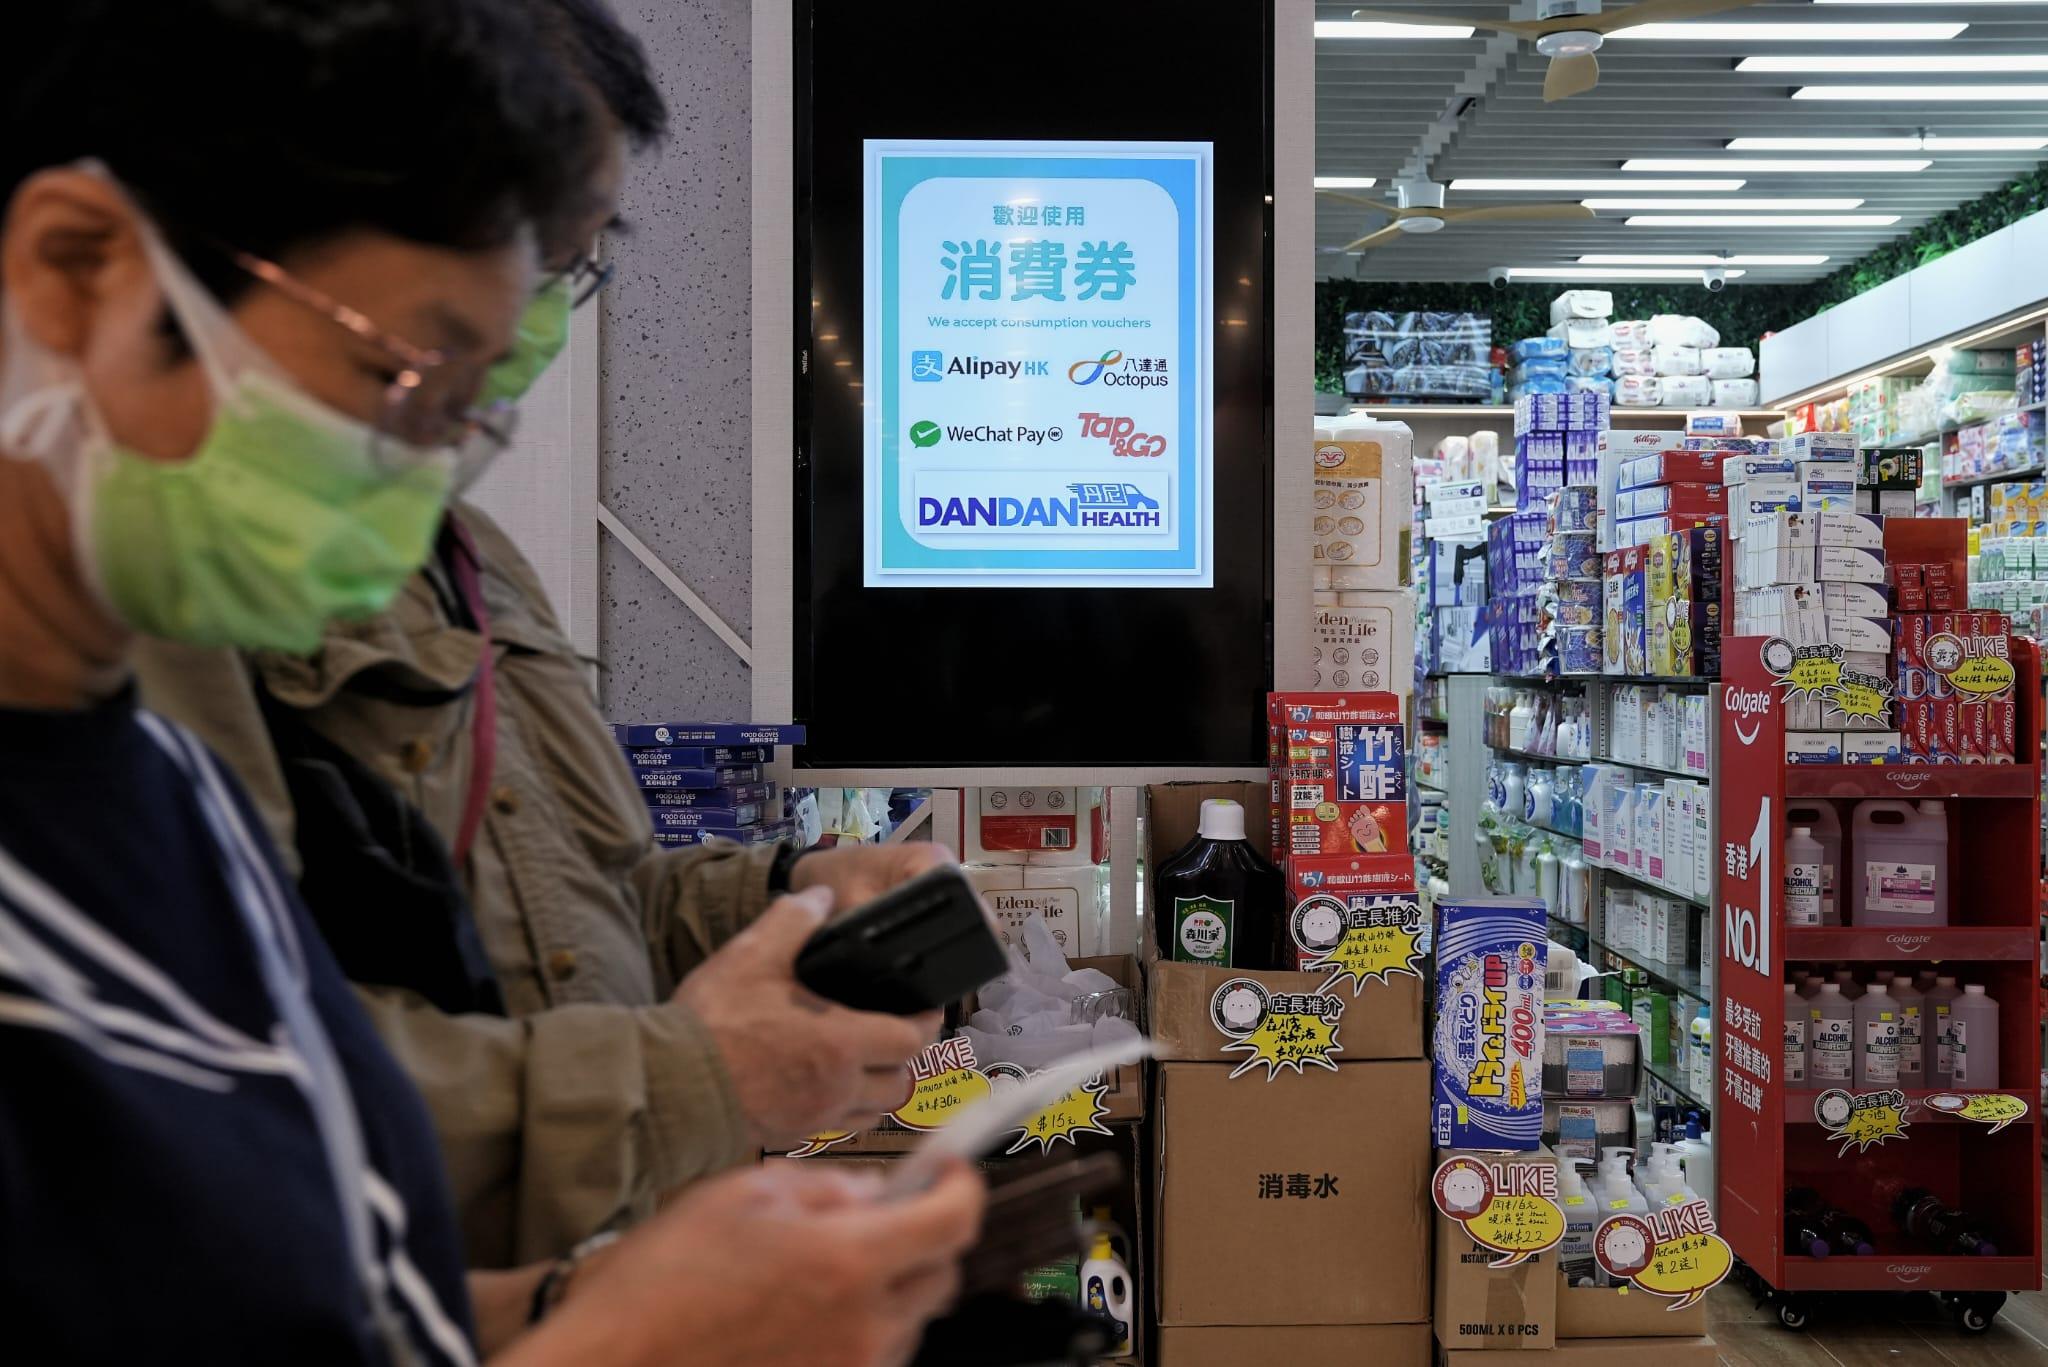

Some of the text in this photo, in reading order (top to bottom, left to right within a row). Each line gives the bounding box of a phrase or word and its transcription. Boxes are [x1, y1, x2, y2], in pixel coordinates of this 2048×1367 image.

[992, 205, 1085, 227] 歡迎使用
[940, 239, 1136, 302] 消費券
[927, 316, 1151, 331] We accept consumption vouchers
[947, 356, 1048, 379] Alipay HK
[1123, 358, 1168, 373] 八達通
[1104, 372, 1168, 389] Octopus
[947, 426, 1013, 443] WeChat
[1017, 426, 1045, 445] Pay
[1078, 412, 1134, 444] Tap
[919, 497, 1078, 527] DANDAN
[1081, 511, 1160, 527] HEALTH
[1348, 623, 1377, 636] Life
[1915, 617, 1924, 657] Colgate
[1797, 643, 1844, 659] 店長推介
[1965, 638, 2008, 658] LIKE
[1848, 672, 1893, 692] 店長推介
[1725, 686, 1771, 719] Colgate
[1918, 703, 1928, 744] Colgate
[1945, 703, 1955, 743] Colgate
[1975, 704, 1984, 744] Colgate
[2003, 704, 2013, 744] Colgate
[1339, 726, 1355, 800] 樹液シート
[1359, 726, 1395, 800] 竹酢
[1886, 771, 1931, 782] Colgate
[1725, 842, 1747, 880] 香港
[1725, 796, 1770, 977] NO. 1
[996, 896, 1034, 910] Eden
[1350, 905, 1421, 928] 店長推介
[1185, 926, 1222, 941] 森川家
[1886, 933, 1931, 945] Colgate
[1271, 996, 1342, 1016] 店長推介
[1725, 996, 1761, 1041] 最多受訪
[1819, 1032, 1849, 1042] ALCOHOL
[911, 1038, 977, 1080] LIKE
[1725, 1032, 1771, 1084] 牙醫推薦的
[1725, 1067, 1762, 1115] 牙膏品牌
[1855, 1092, 1903, 1110] 店長推介
[1258, 1173, 1340, 1199] 消毒水
[1493, 1166, 1557, 1197] LIKE
[1648, 1203, 1715, 1243] LIKE
[1461, 1253, 1489, 1264] INSTANT
[1654, 1246, 1680, 1257] Action
[1886, 1264, 1931, 1275] Colgate
[1459, 1323, 1539, 1336] 500ML X 6 PCS
